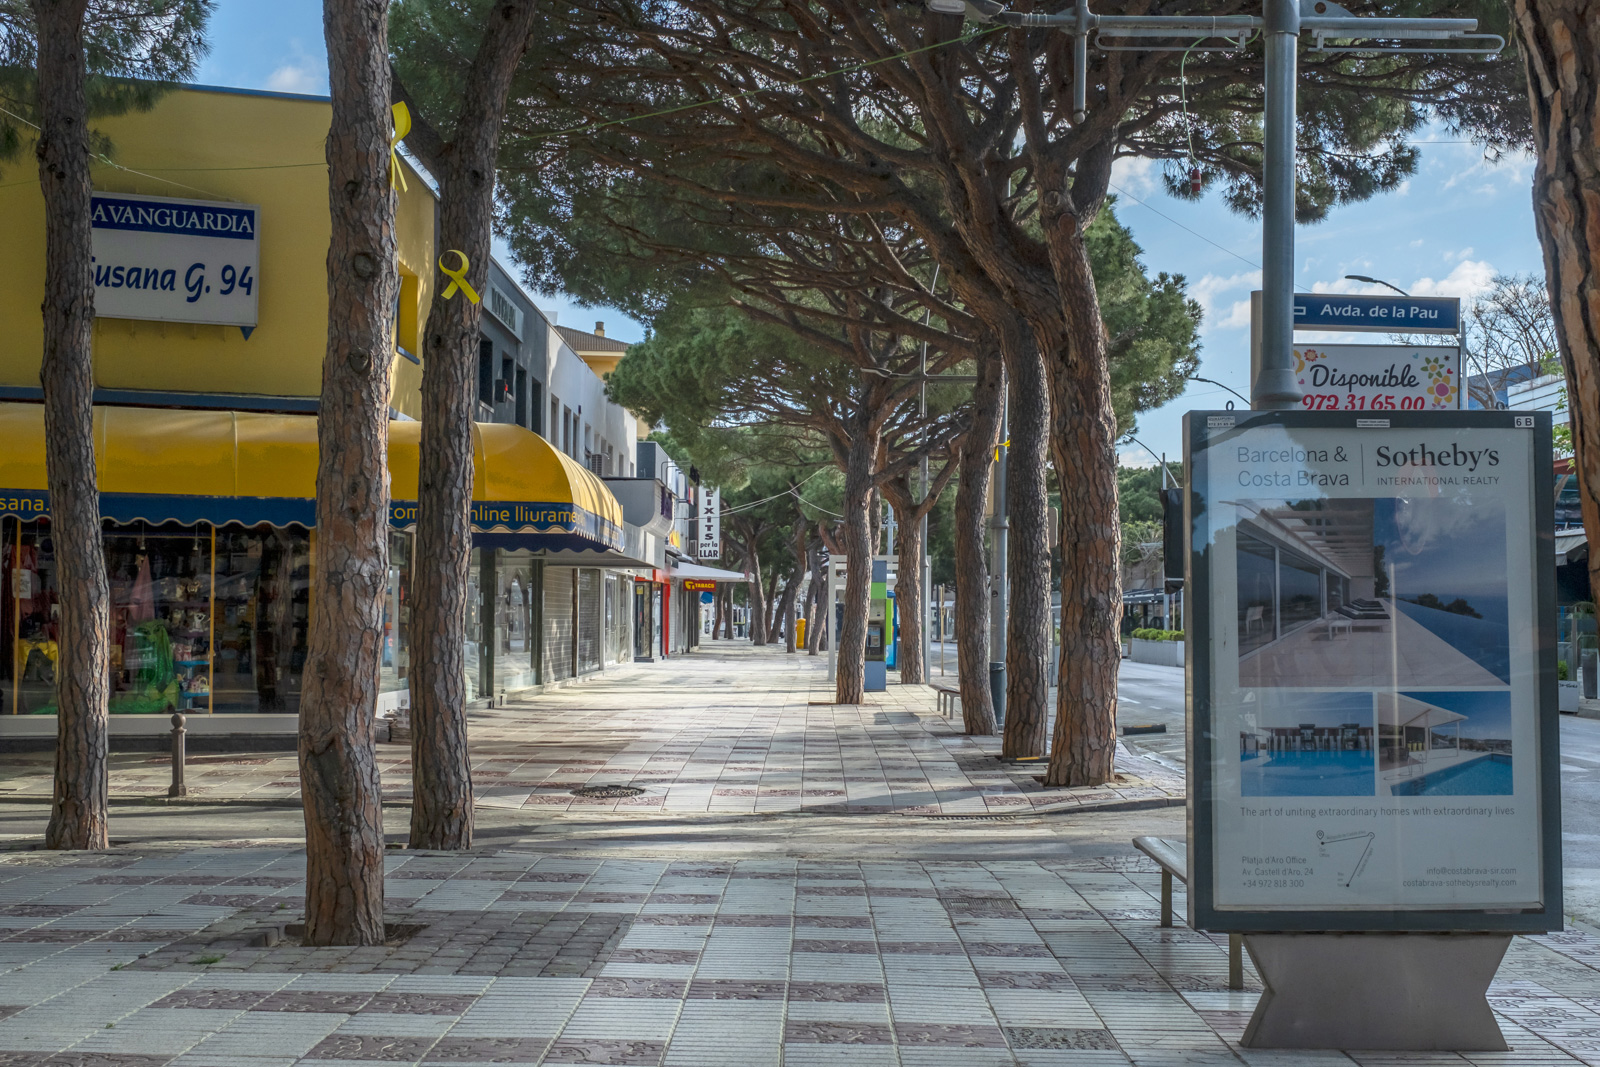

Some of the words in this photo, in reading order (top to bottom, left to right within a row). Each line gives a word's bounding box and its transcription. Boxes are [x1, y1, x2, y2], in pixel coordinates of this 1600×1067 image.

[91, 256, 176, 292] usana
[184, 262, 211, 303] G.
[220, 264, 254, 296] 94
[1320, 304, 1364, 317] Avda.
[1369, 305, 1388, 318] de
[1392, 306, 1405, 318] la
[1410, 306, 1438, 319] Pau
[1310, 364, 1420, 392] Disponible
[1302, 394, 1339, 410] 972
[1345, 394, 1366, 410] 31
[1370, 394, 1396, 410] 65
[1400, 396, 1425, 410] 00
[1516, 418, 1522, 427] 6
[1525, 418, 1533, 427] B
[1237, 446, 1328, 463] Barcelona
[1333, 445, 1348, 463] &
[1376, 443, 1499, 471] Sotheby's
[1238, 471, 1291, 487] Costa
[1297, 471, 1349, 487] Brava
[1377, 477, 1460, 486] INTERNATIONAL
[1463, 476, 1499, 486] REALTY
[700, 550, 718, 558] LLAR
[1240, 807, 1256, 817] The
[1259, 807, 1272, 817] art
[1275, 807, 1284, 817] of
[1285, 807, 1316, 818] uniting
[1318, 806, 1377, 818] extraordinary
[1380, 807, 1410, 816] homes
[1412, 806, 1431, 816] with
[1433, 806, 1493, 818] extraordinary
[1495, 806, 1515, 816] lives
[1242, 856, 1262, 866] Platja
[1285, 856, 1307, 865] Office
[1255, 867, 1280, 876] Castell
[1304, 868, 1314, 877] 24
[1242, 880, 1256, 888] +34
[1258, 880, 1272, 888] 972
[1289, 880, 1304, 888] 300
